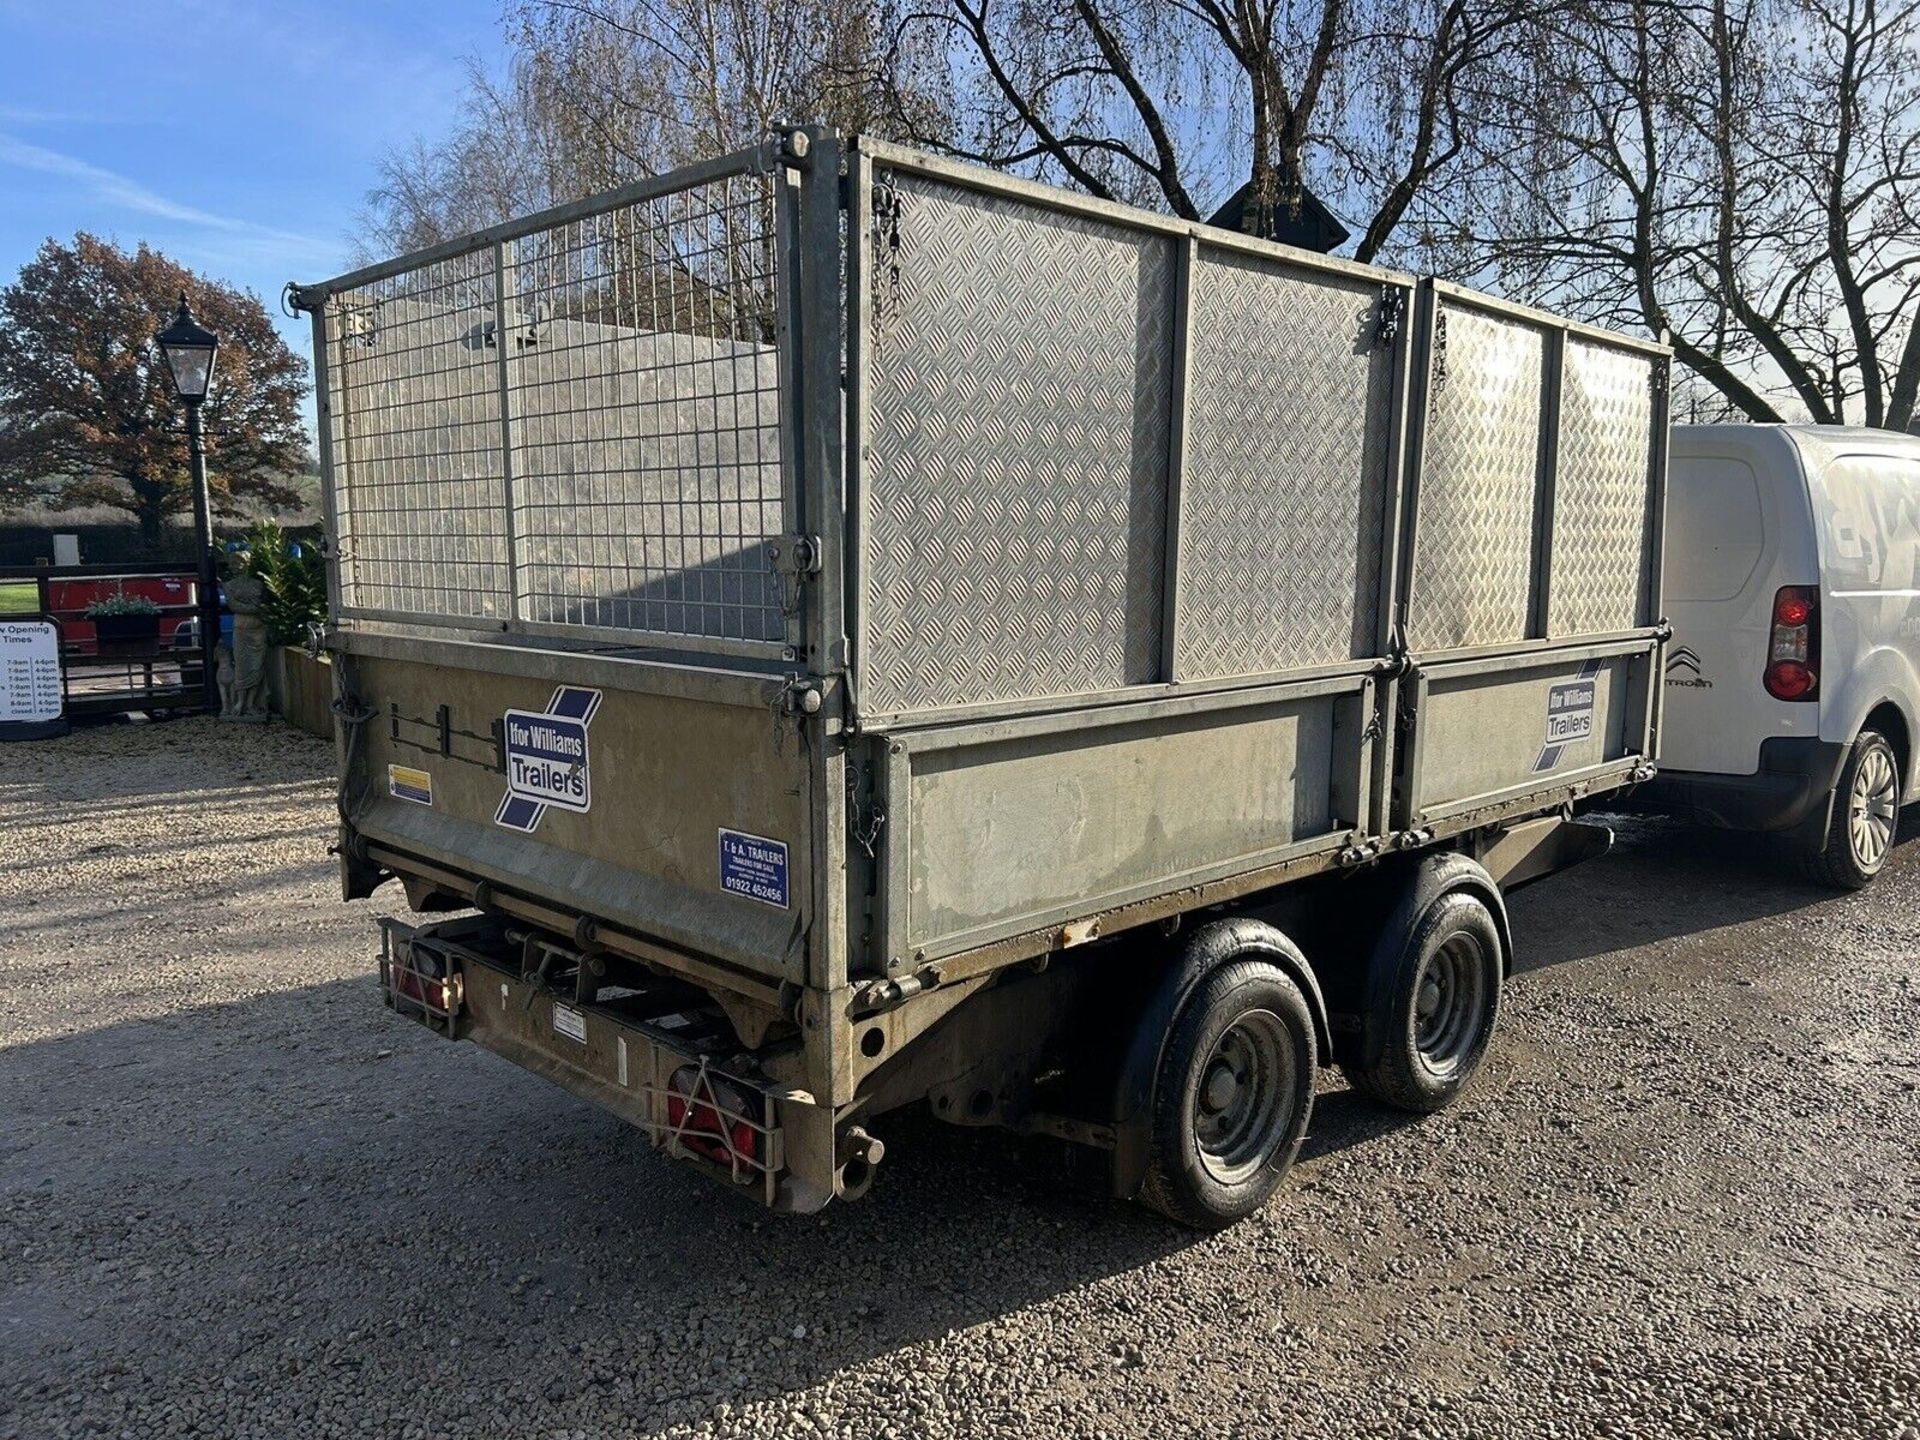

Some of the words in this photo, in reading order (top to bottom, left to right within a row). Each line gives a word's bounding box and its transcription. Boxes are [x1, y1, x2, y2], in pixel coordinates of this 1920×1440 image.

[3, 635, 32, 643] Times
[8, 625, 50, 634] Opening
[1563, 689, 1593, 706] Williams
[1549, 715, 1590, 736] Trailers
[510, 722, 529, 746] Ifor
[530, 725, 582, 756] Williams
[512, 757, 583, 796] Trailers
[747, 846, 784, 866] TRAILERS
[726, 876, 751, 893] 01922
[752, 883, 782, 901] 452456
